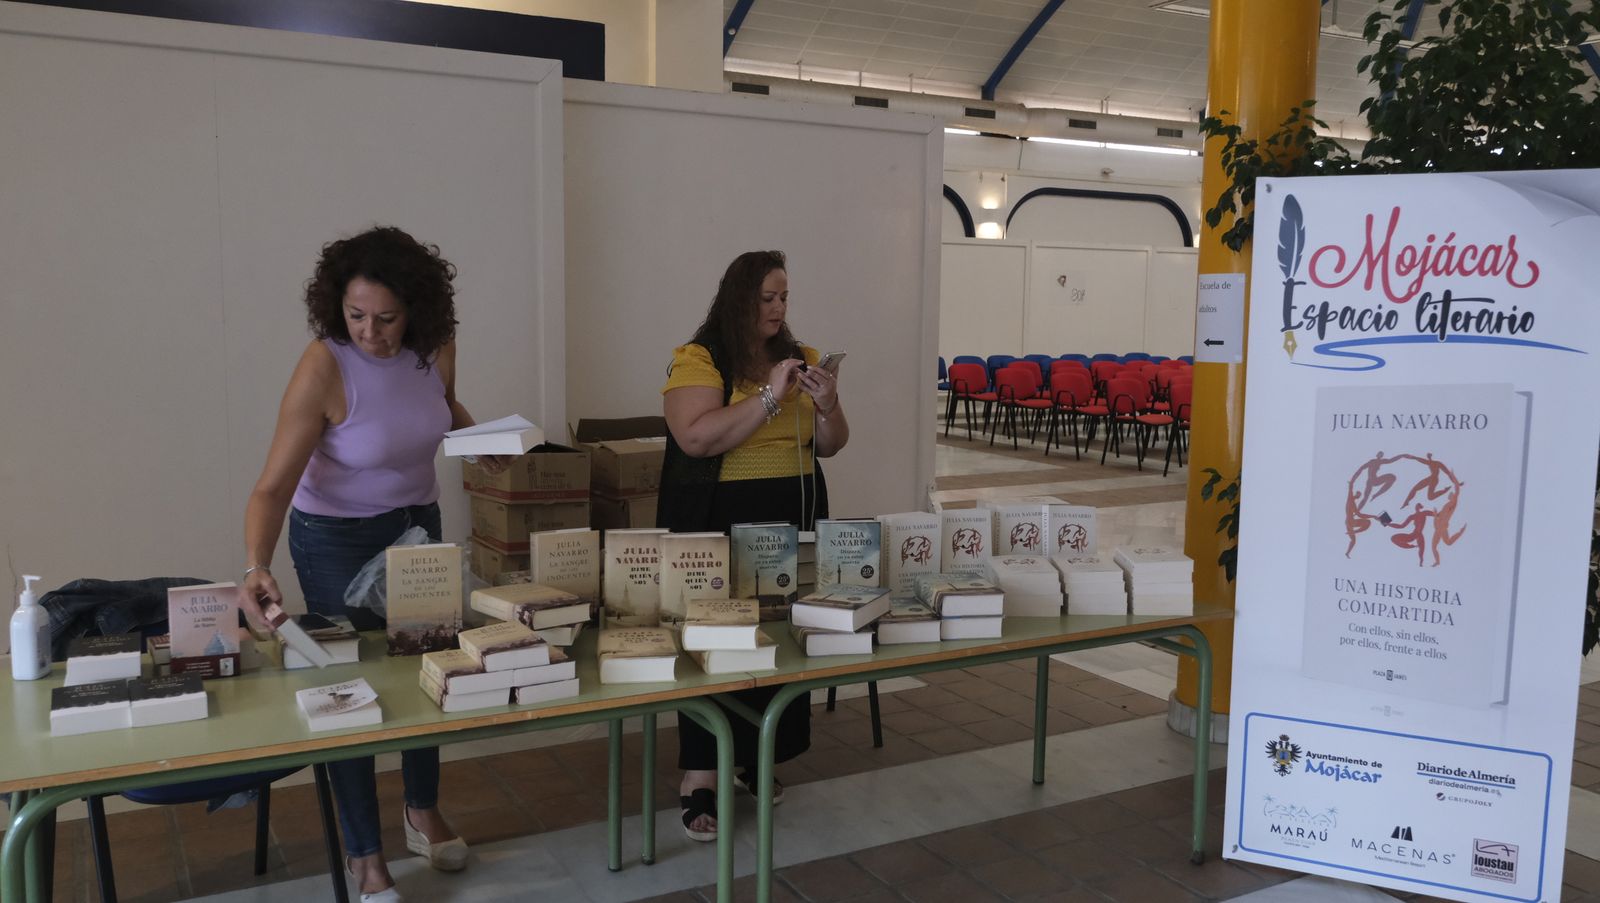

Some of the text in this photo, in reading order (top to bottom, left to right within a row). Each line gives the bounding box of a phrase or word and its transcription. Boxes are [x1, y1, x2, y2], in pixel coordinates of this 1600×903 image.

[1308, 206, 1539, 303] Mojácar
[1221, 281, 1232, 289] de
[1280, 278, 1534, 341] Espacio literario
[1331, 413, 1488, 432] JULIA NAVARRO
[756, 535, 782, 543] JULIA
[838, 531, 864, 539] JULIA
[557, 541, 581, 549] JULIA
[747, 543, 790, 552] NAVARRO
[830, 538, 873, 547] NAVARRO
[549, 549, 589, 558] NAVARRO
[623, 547, 657, 555] JULIA
[410, 557, 439, 566] JULIA
[671, 561, 723, 569] NAVARRO
[401, 566, 448, 575] NAVARRO
[1334, 577, 1462, 606] UNA HISTORIA
[191, 595, 218, 606] JULIA
[180, 604, 229, 615] NAVARRO
[1338, 598, 1455, 626] COMPARTIDA
[1348, 622, 1367, 634] Con
[1396, 629, 1411, 641] sin
[1340, 636, 1356, 645] por
[1384, 641, 1414, 656] frente
[1416, 648, 1422, 656] a
[1424, 648, 1447, 660] ellos
[1305, 750, 1383, 769] Ayuntamiento de
[1305, 758, 1382, 783] Mojácar
[1417, 762, 1516, 785] Diario de Almería
[1270, 823, 1328, 842] MARAÚ
[1474, 853, 1514, 871] loustau
[1474, 866, 1514, 878] ABOGADOS
